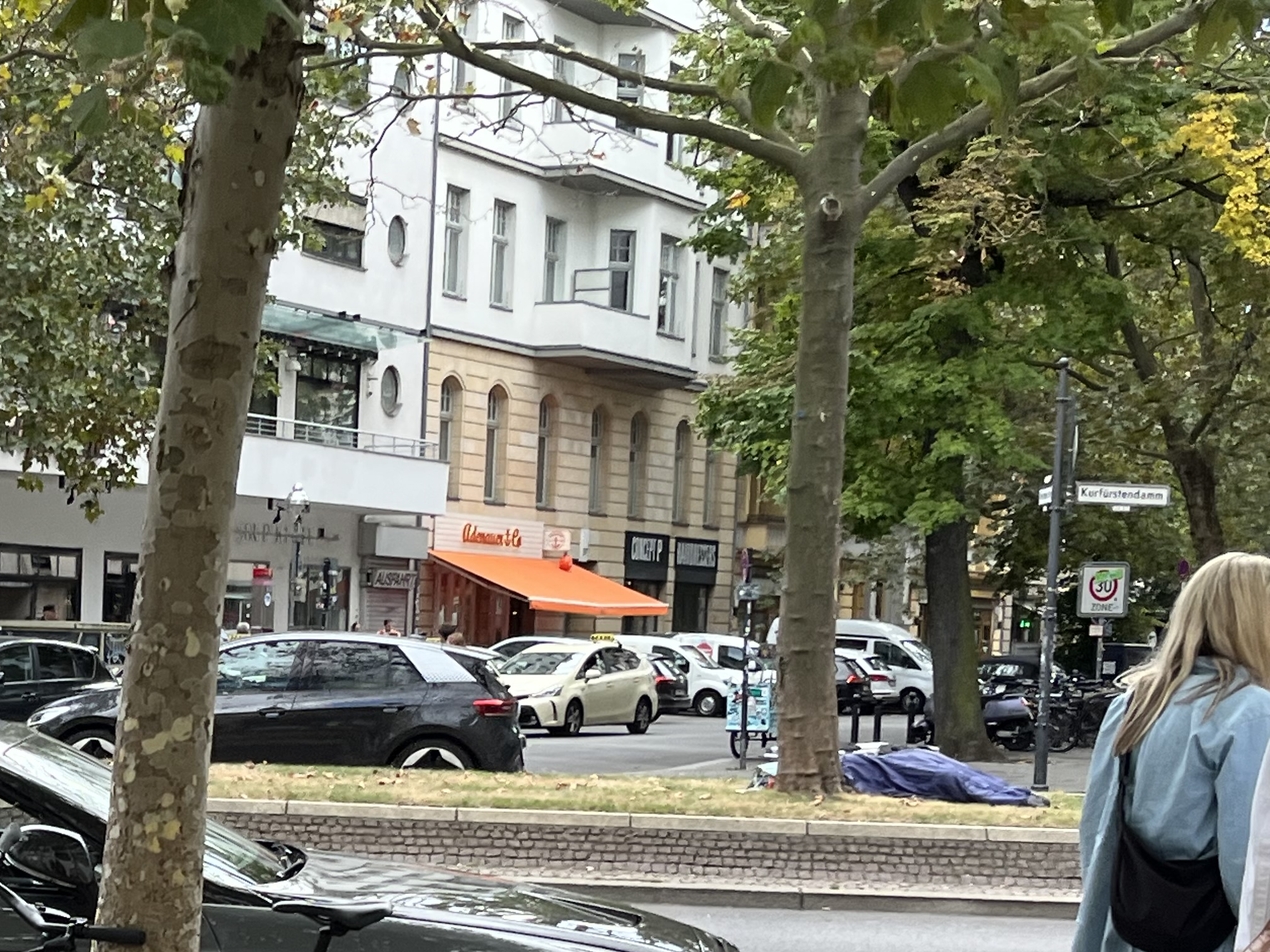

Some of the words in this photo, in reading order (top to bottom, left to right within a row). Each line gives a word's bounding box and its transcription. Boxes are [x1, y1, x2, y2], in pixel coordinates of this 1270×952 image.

[1081, 487, 1164, 500] Kurfürstendamm
[374, 570, 417, 588] AUSFAHRT
[1095, 579, 1113, 593] 30
[1091, 603, 1114, 612] ZONE
